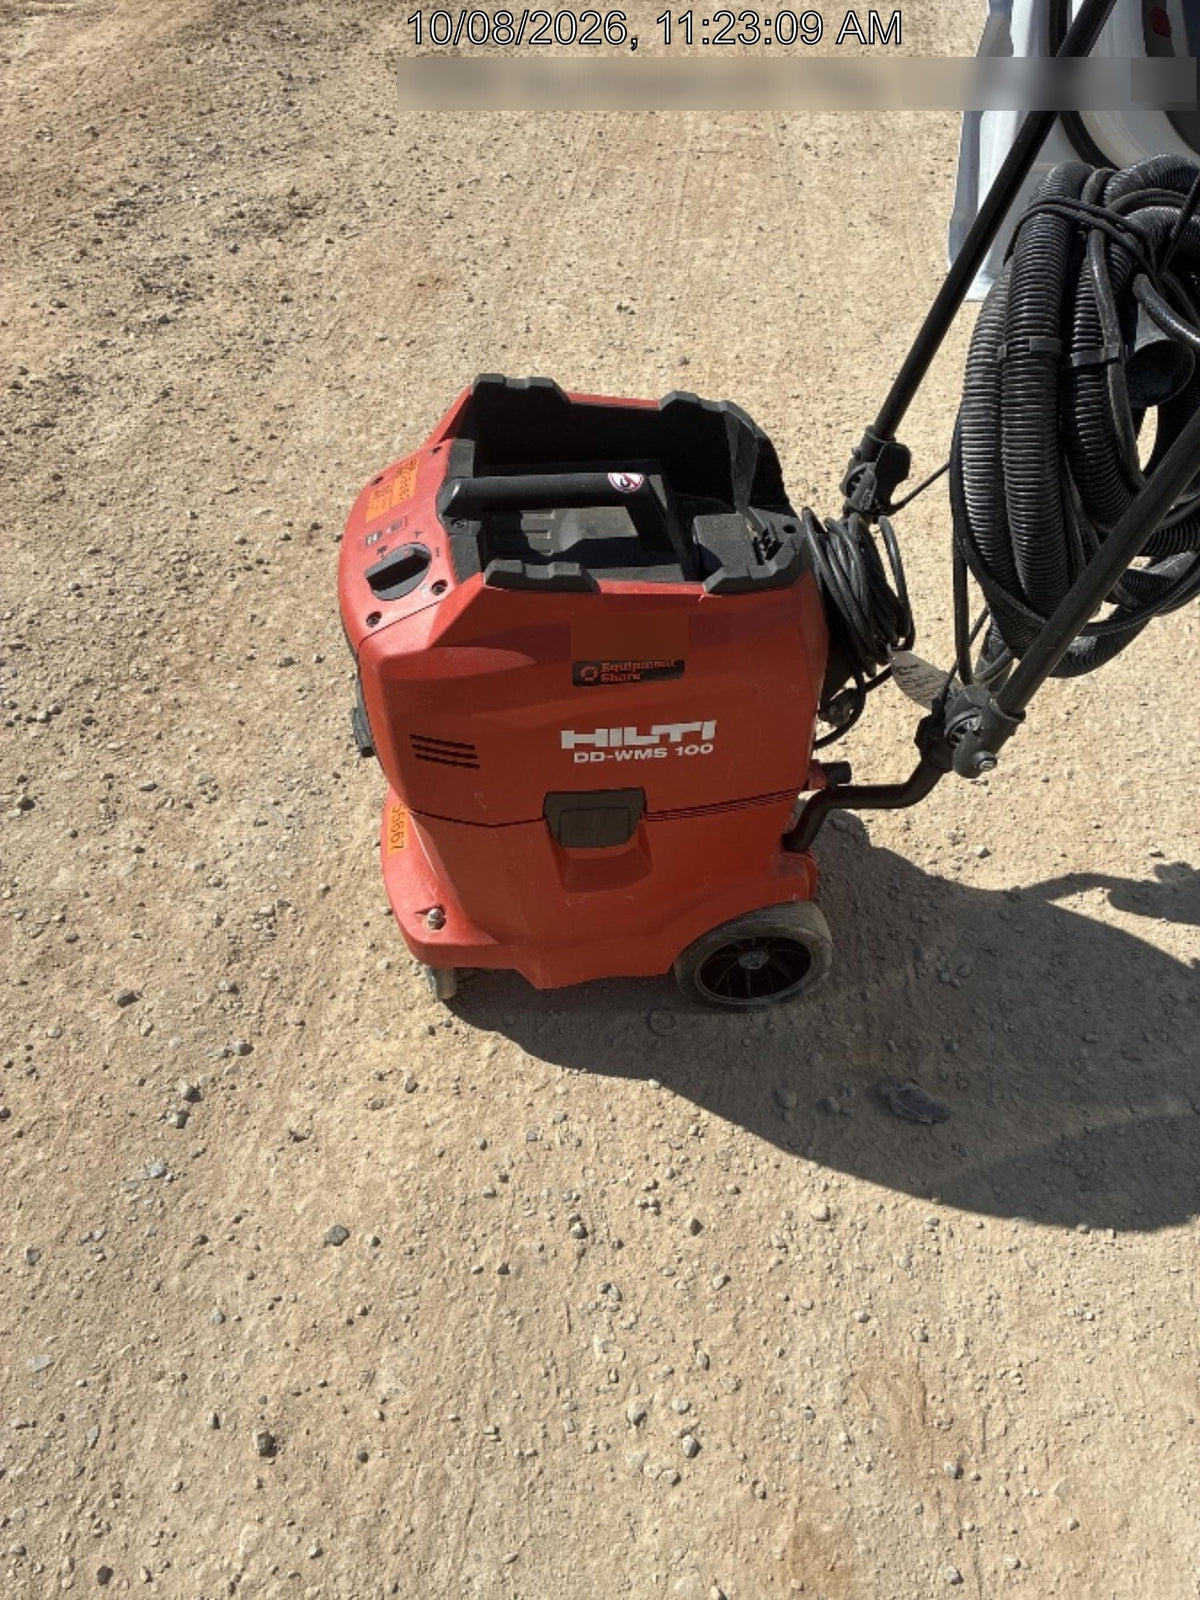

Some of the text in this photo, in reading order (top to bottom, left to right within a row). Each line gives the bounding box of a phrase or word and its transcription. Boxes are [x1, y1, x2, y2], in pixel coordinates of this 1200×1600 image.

[601, 660, 676, 673] Equipment
[601, 673, 641, 683] Share
[560, 719, 717, 749] HILTI
[573, 742, 714, 764] DD-WMS 100
